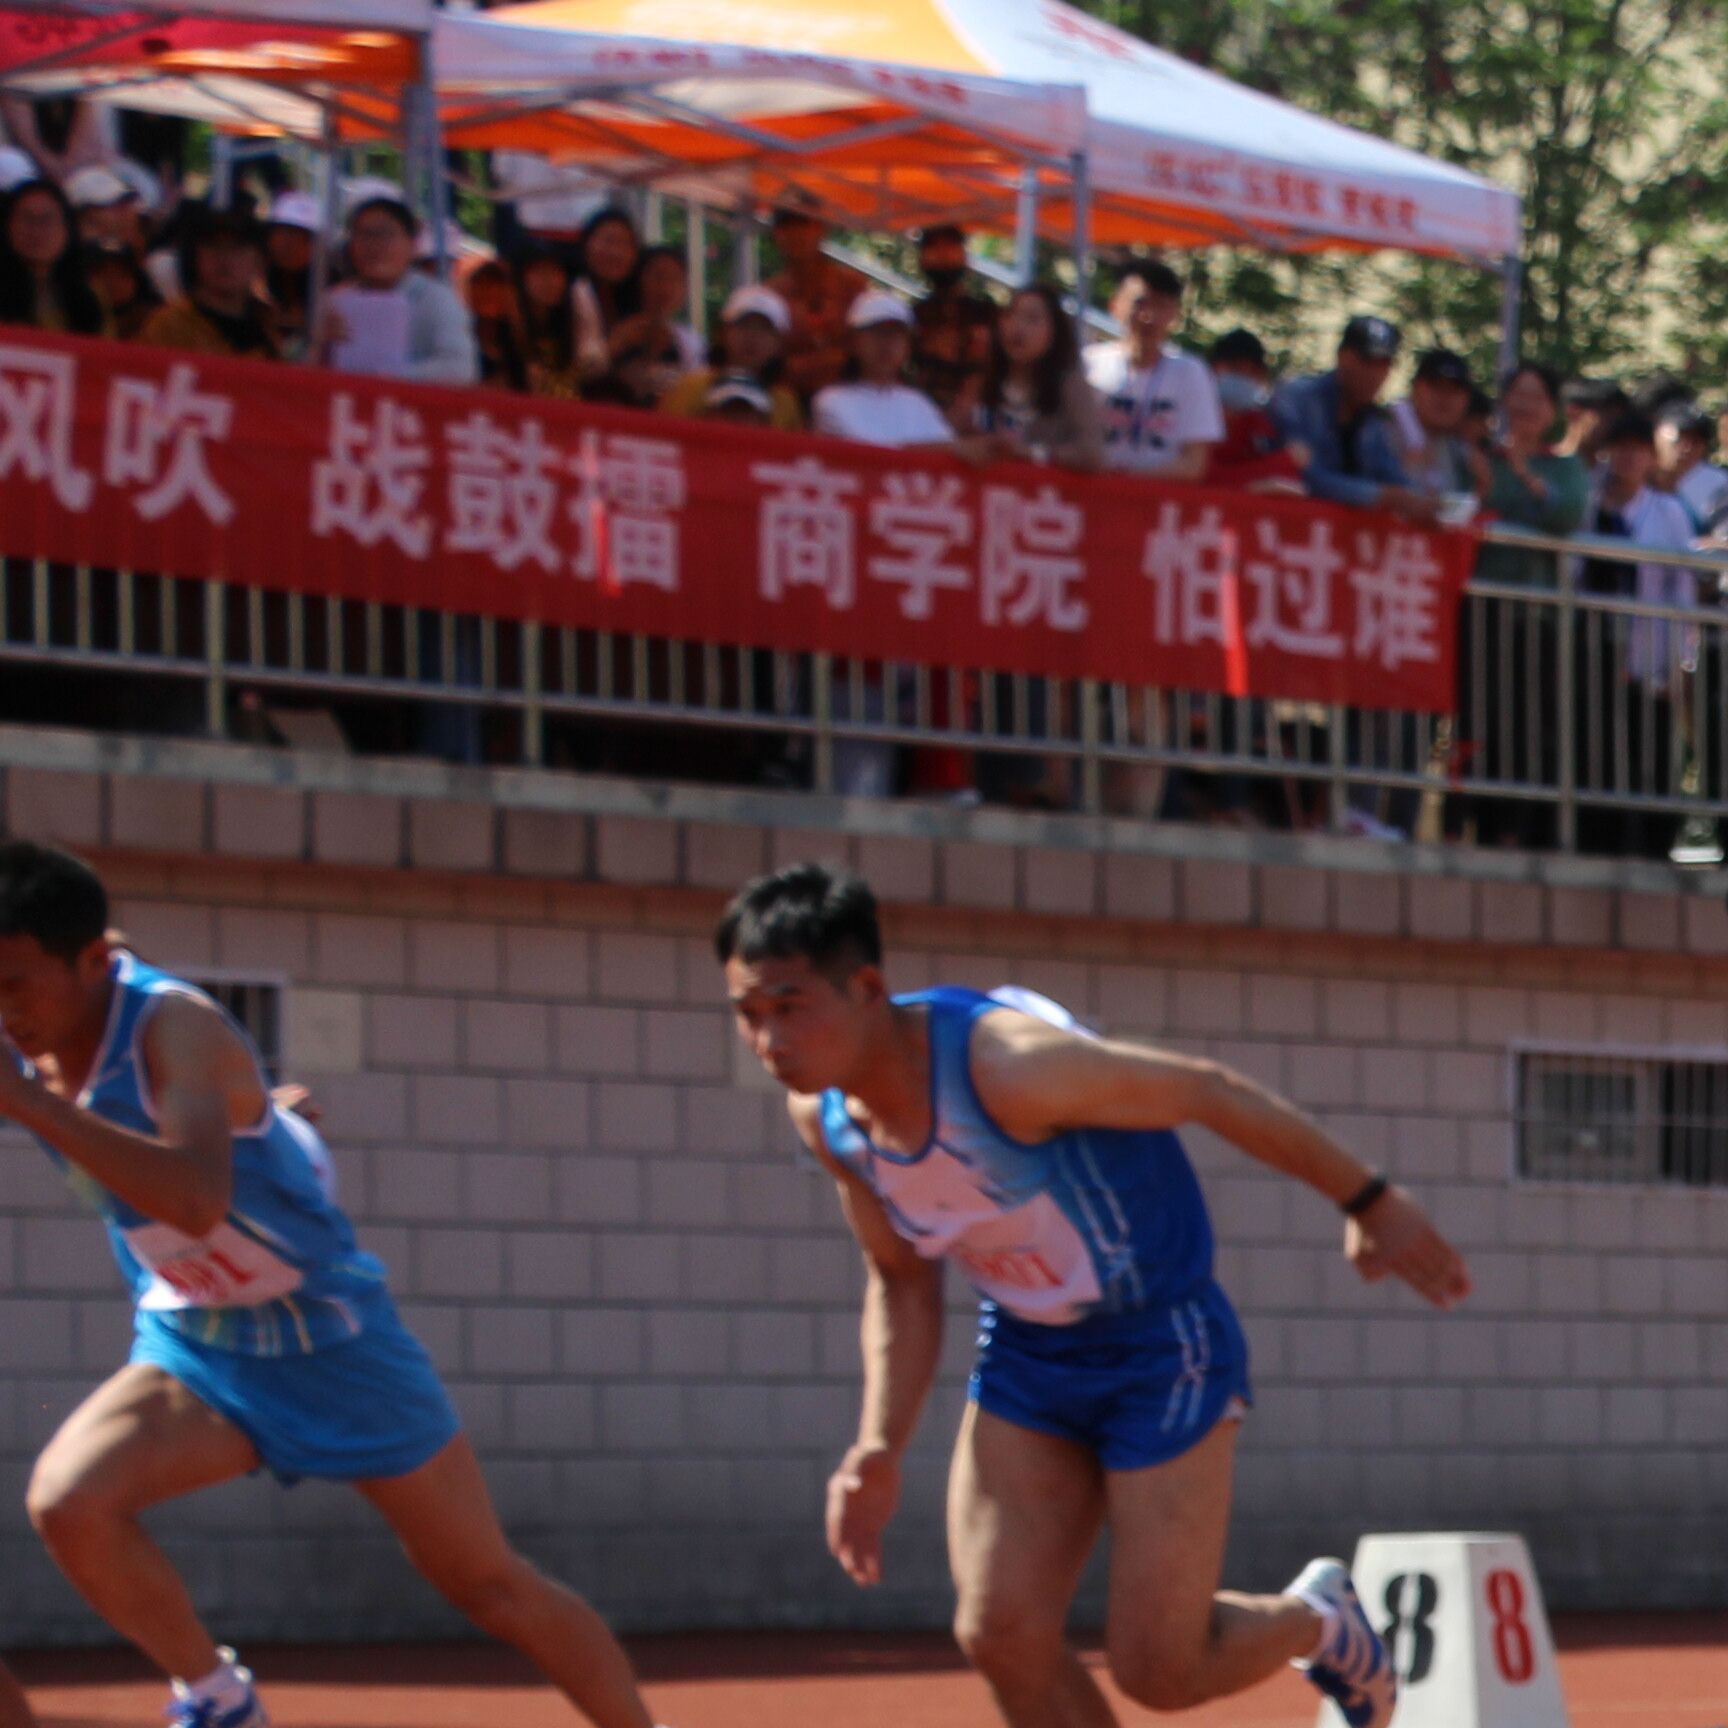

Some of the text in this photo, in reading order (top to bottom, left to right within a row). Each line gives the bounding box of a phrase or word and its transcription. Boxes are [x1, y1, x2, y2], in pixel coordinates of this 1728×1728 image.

[311, 395, 686, 592] 战鼓擂
[751, 458, 1089, 632] 商学院
[1143, 501, 1446, 668] 怕过谁
[1383, 1572, 1438, 1684] 8
[1486, 1570, 1534, 1684] 8
